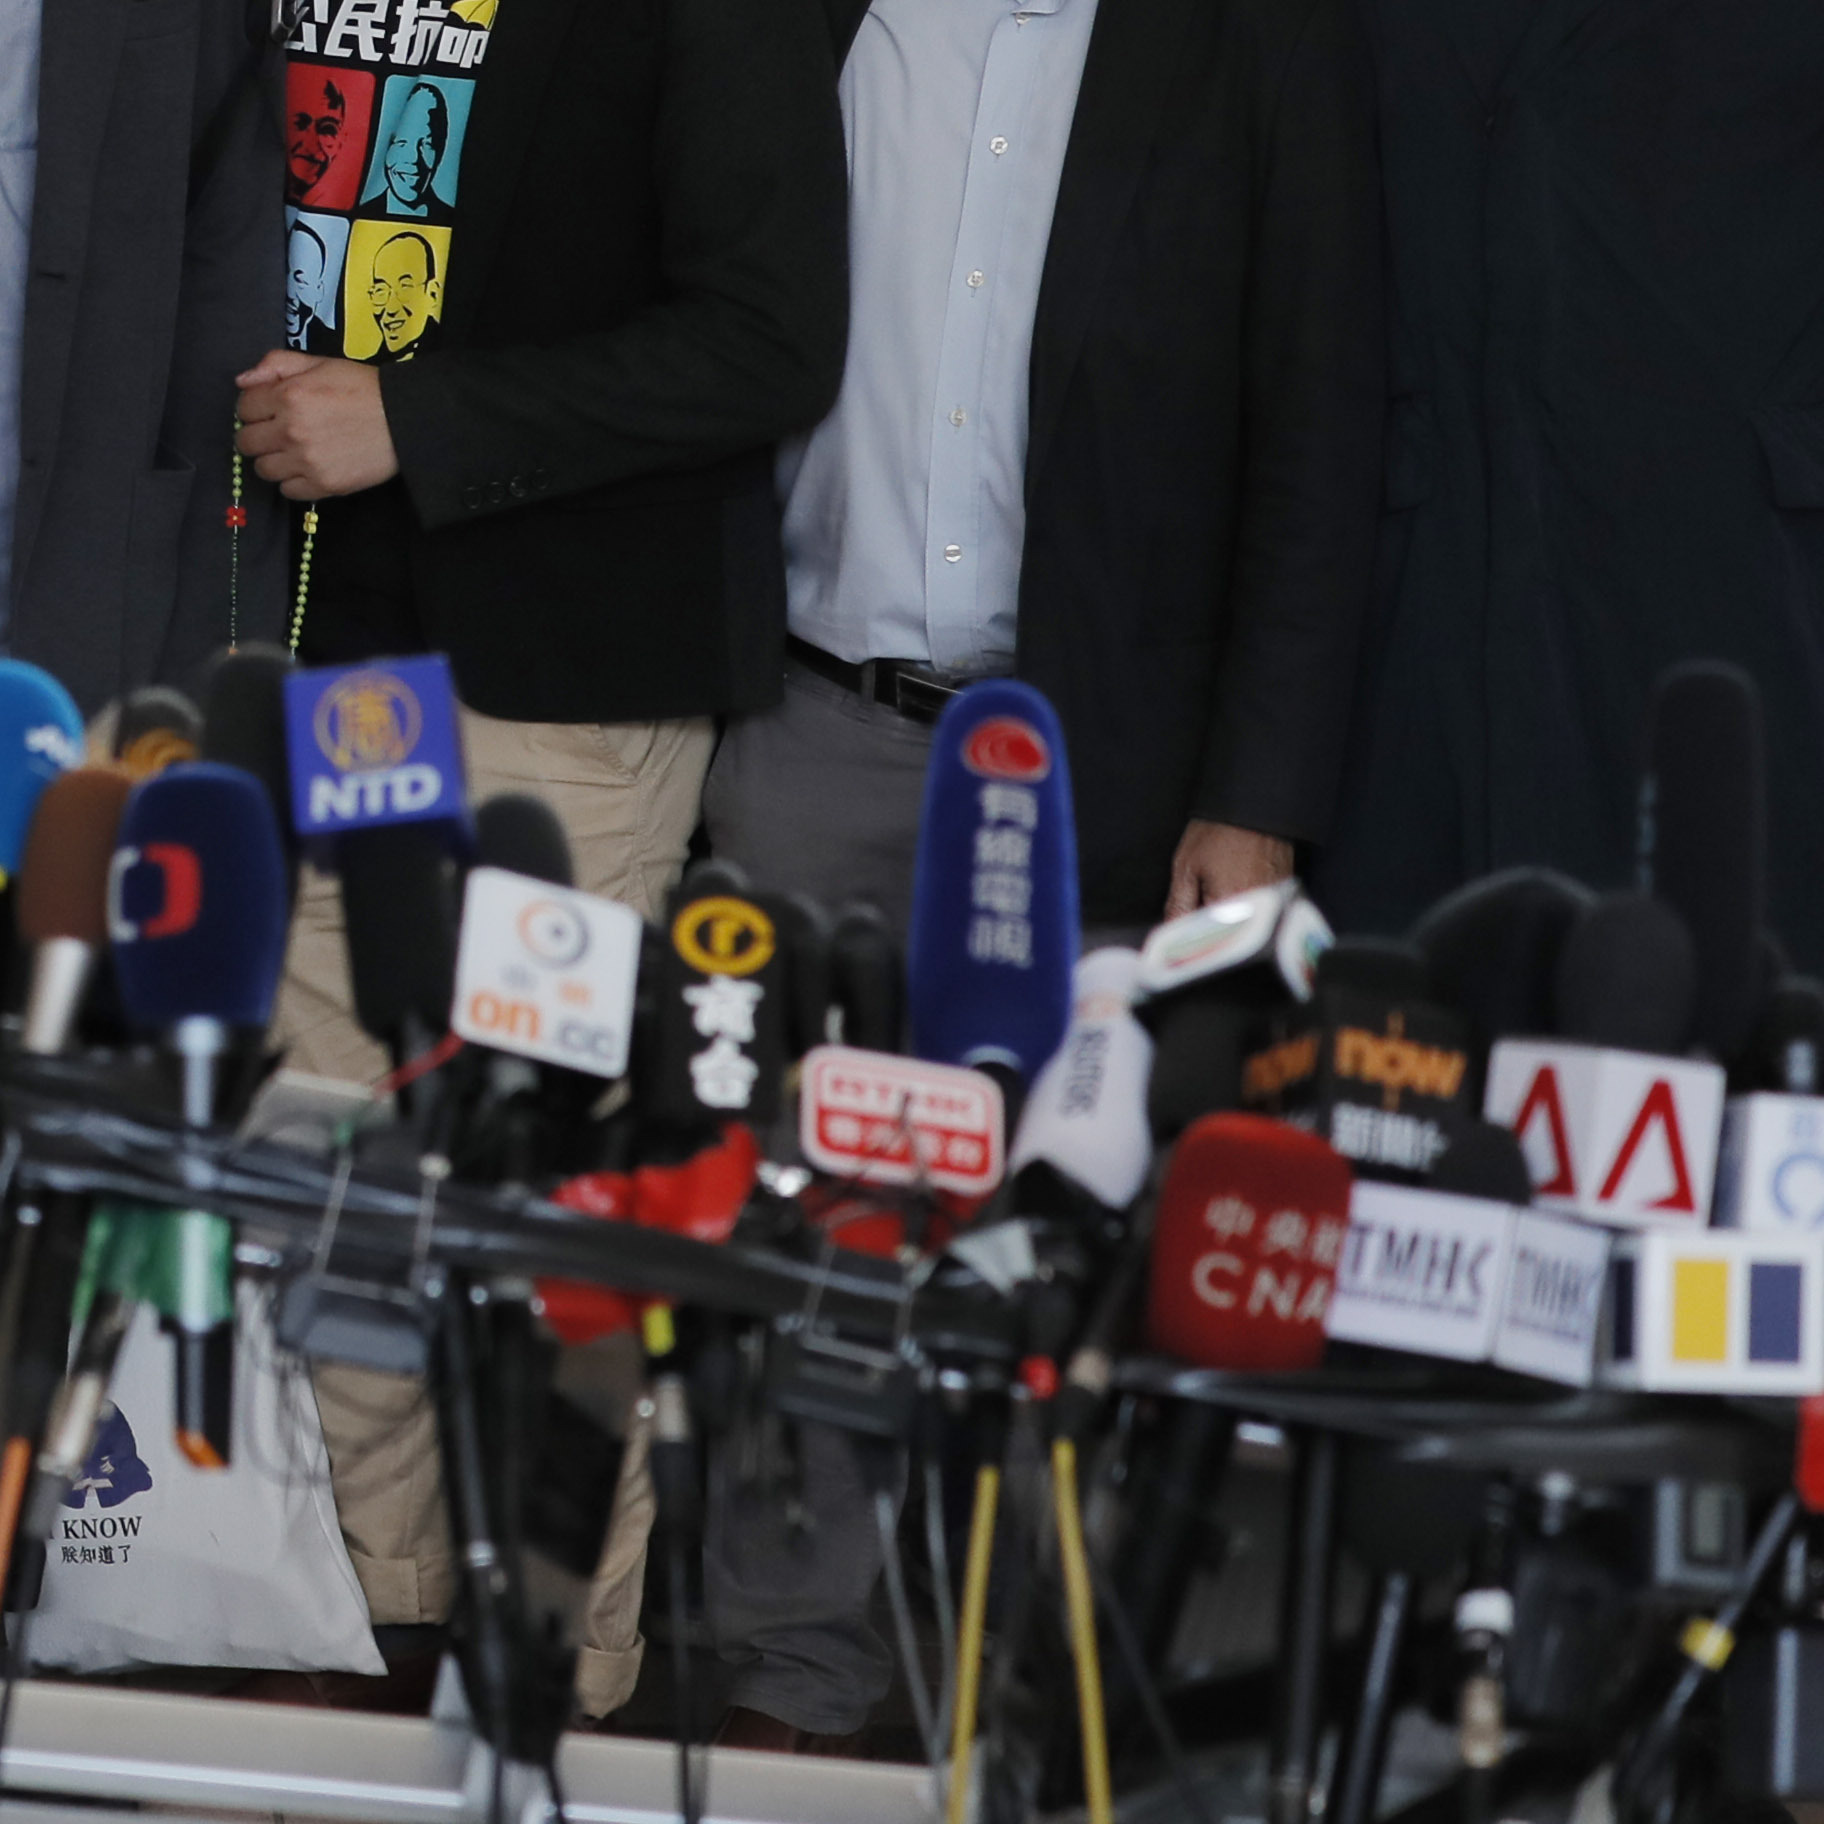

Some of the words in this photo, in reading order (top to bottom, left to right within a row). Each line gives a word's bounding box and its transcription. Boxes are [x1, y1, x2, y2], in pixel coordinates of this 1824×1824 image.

[309, 764, 442, 822] NTD
[62, 1516, 142, 1539] KNOW
[61, 1544, 131, 1564] 朕知道了
